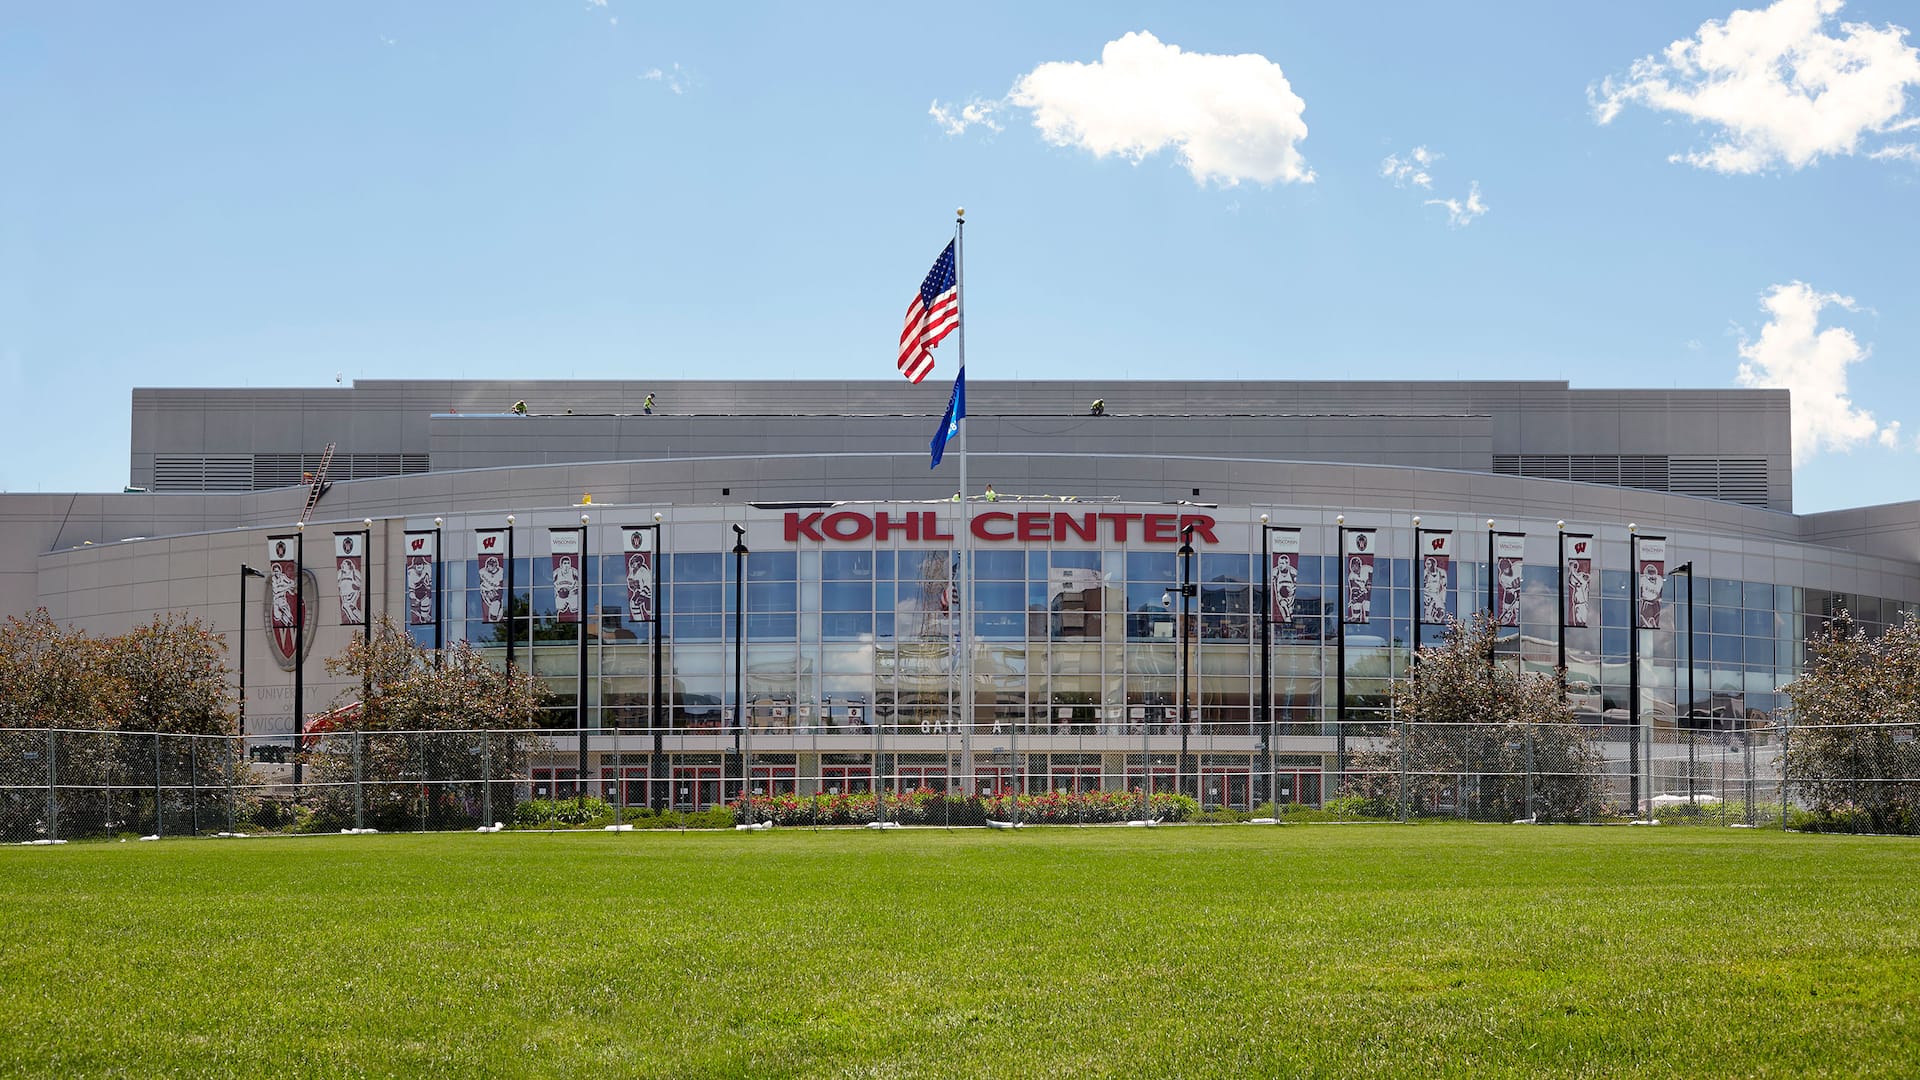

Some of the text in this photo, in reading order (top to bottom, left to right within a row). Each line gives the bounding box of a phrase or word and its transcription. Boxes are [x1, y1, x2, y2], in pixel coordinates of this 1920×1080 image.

[784, 511, 1219, 543] KOHL CENTER
[257, 687, 319, 699] UNIVERTY
[250, 716, 295, 731] WISCO
[992, 719, 1002, 733] A
